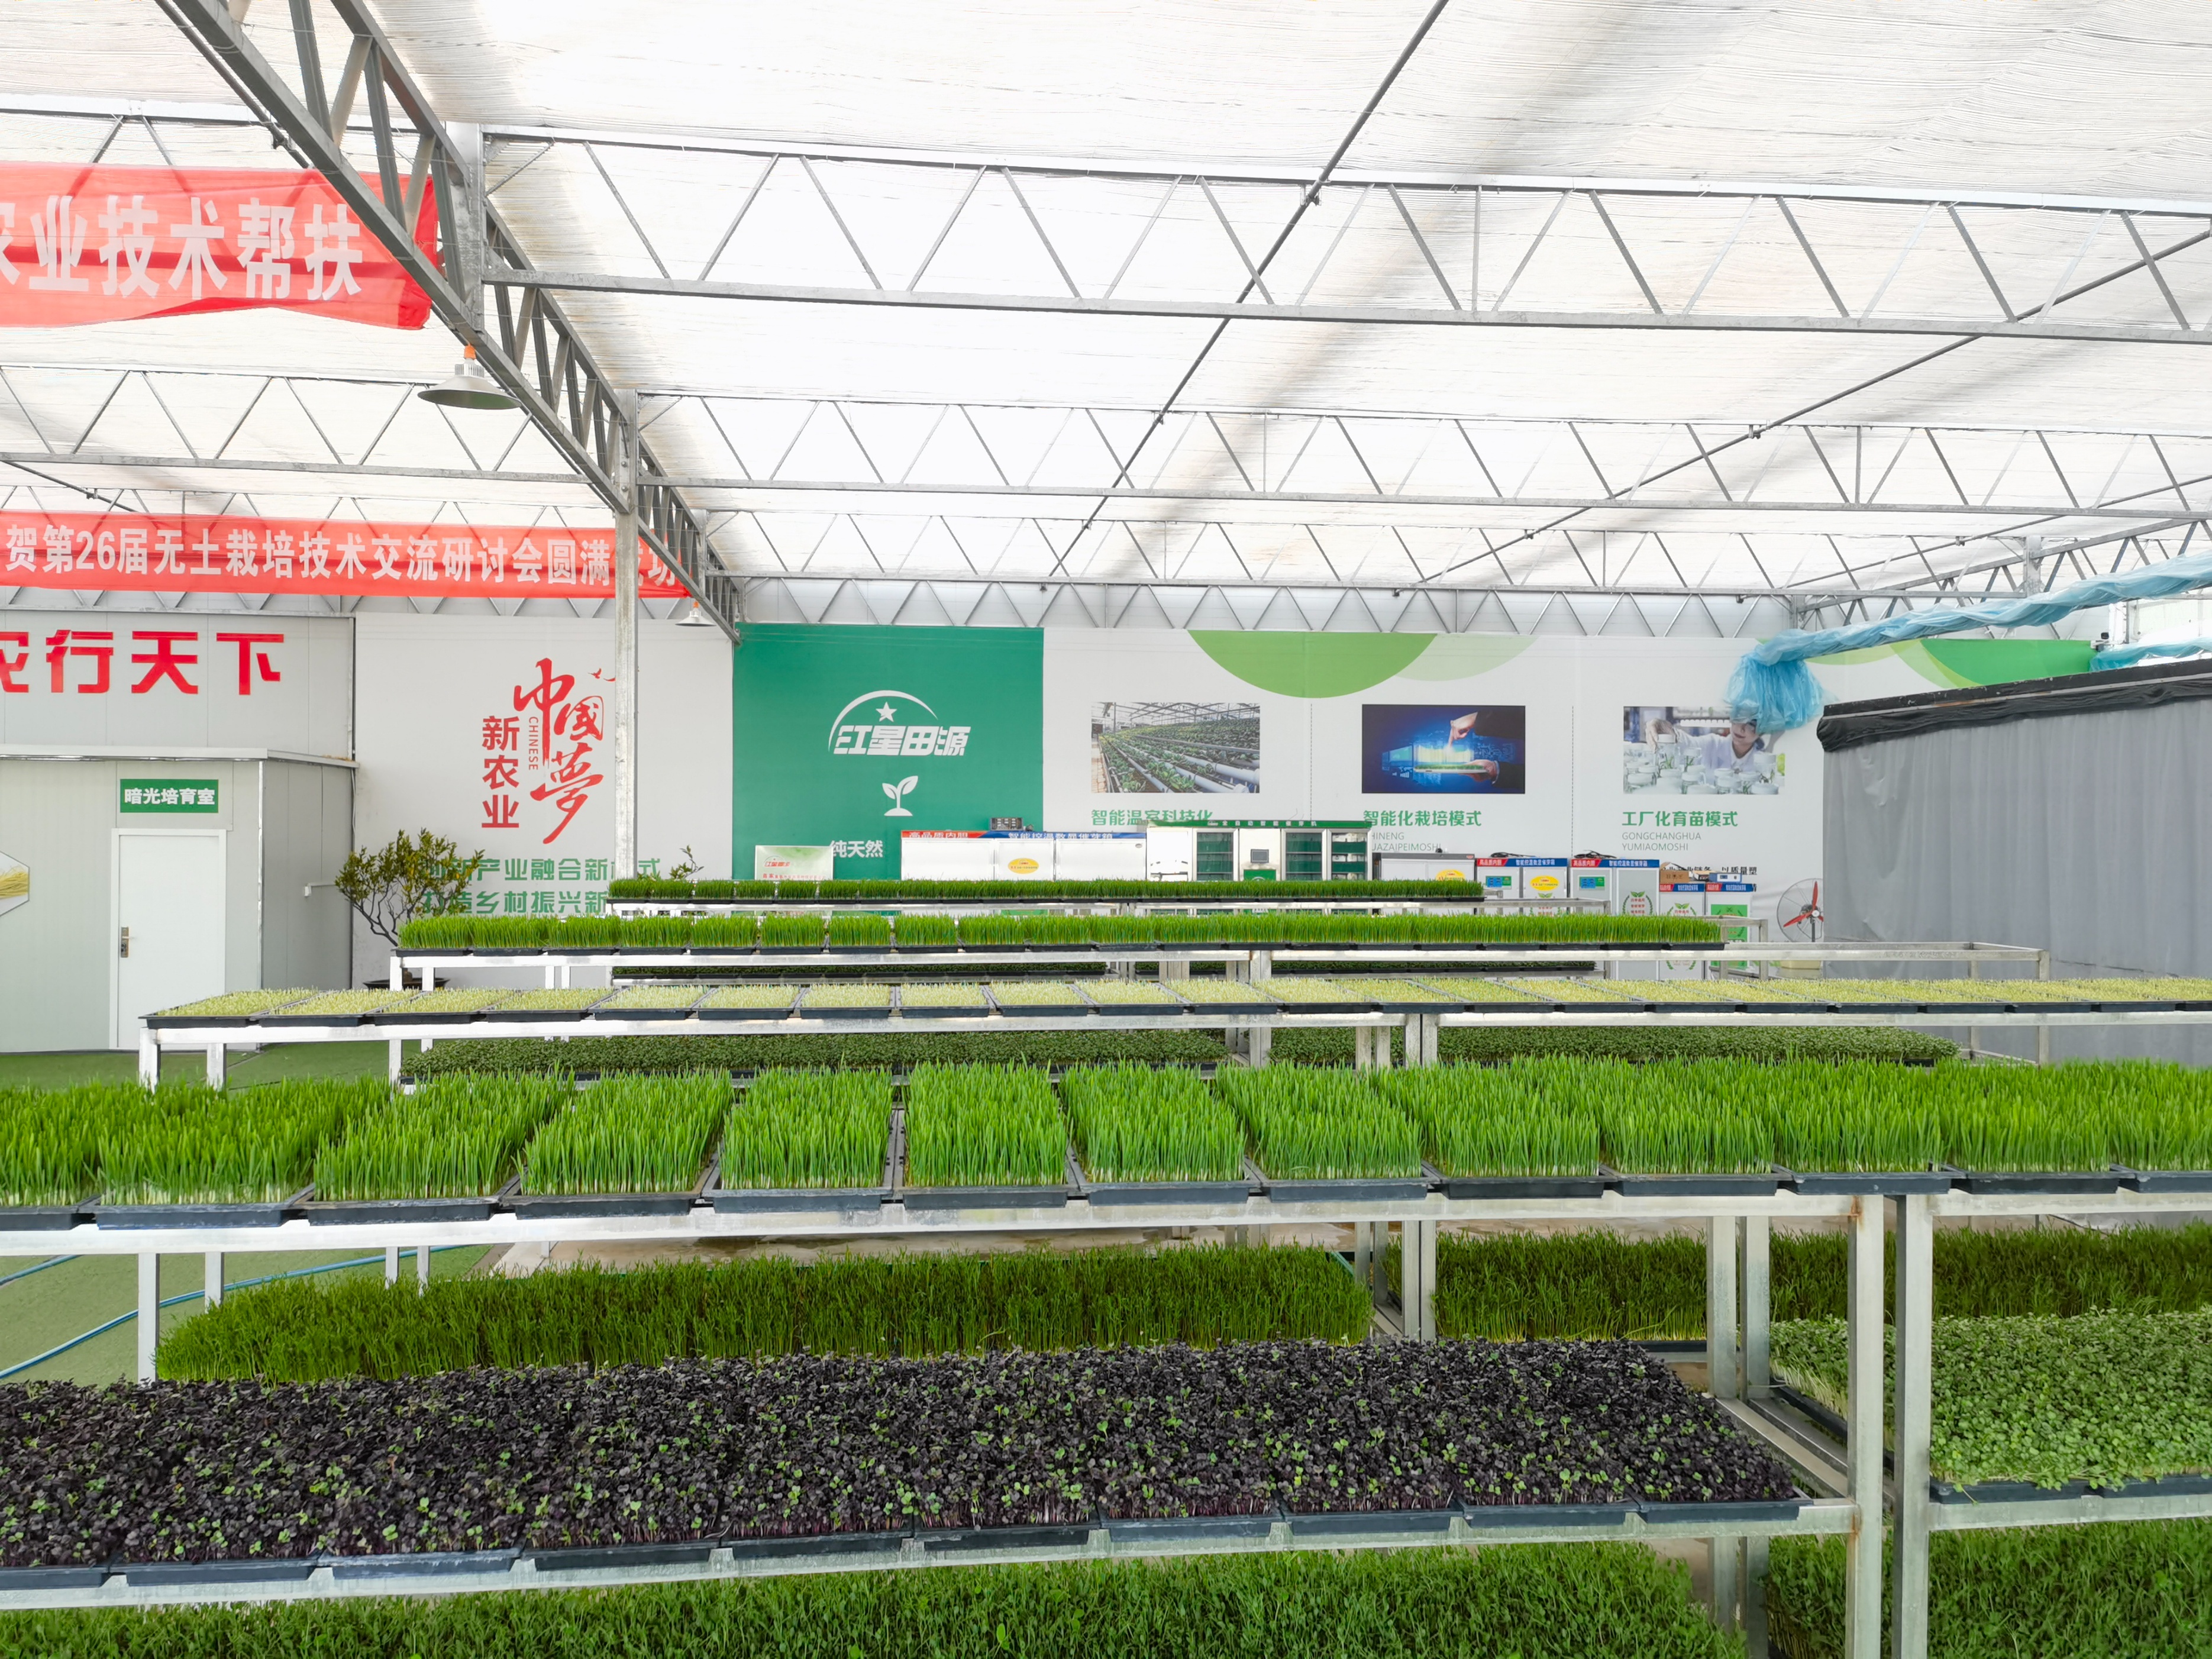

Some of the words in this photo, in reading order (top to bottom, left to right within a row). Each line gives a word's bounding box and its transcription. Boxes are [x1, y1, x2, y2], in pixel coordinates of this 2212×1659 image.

[5, 524, 676, 587] 贺第26届无土栽培技术交流研讨会圆满功
[528, 716, 538, 770] CHINESE
[833, 725, 971, 756] 红星田源
[482, 715, 520, 828] 新农业
[124, 787, 215, 805] 暗光培育室
[1092, 809, 1213, 826] 智能温室科技化
[1364, 810, 1482, 827] 智能化栽培模式
[1622, 811, 1739, 827] 工厂化育苗模式
[1371, 832, 1404, 840] HINENG
[1622, 832, 1701, 840] GONGCHANGHUA
[829, 840, 883, 858] 纯天然
[1372, 843, 1441, 851] UAZAIPEIMOSHI
[424, 858, 661, 881] 新产业融合新式
